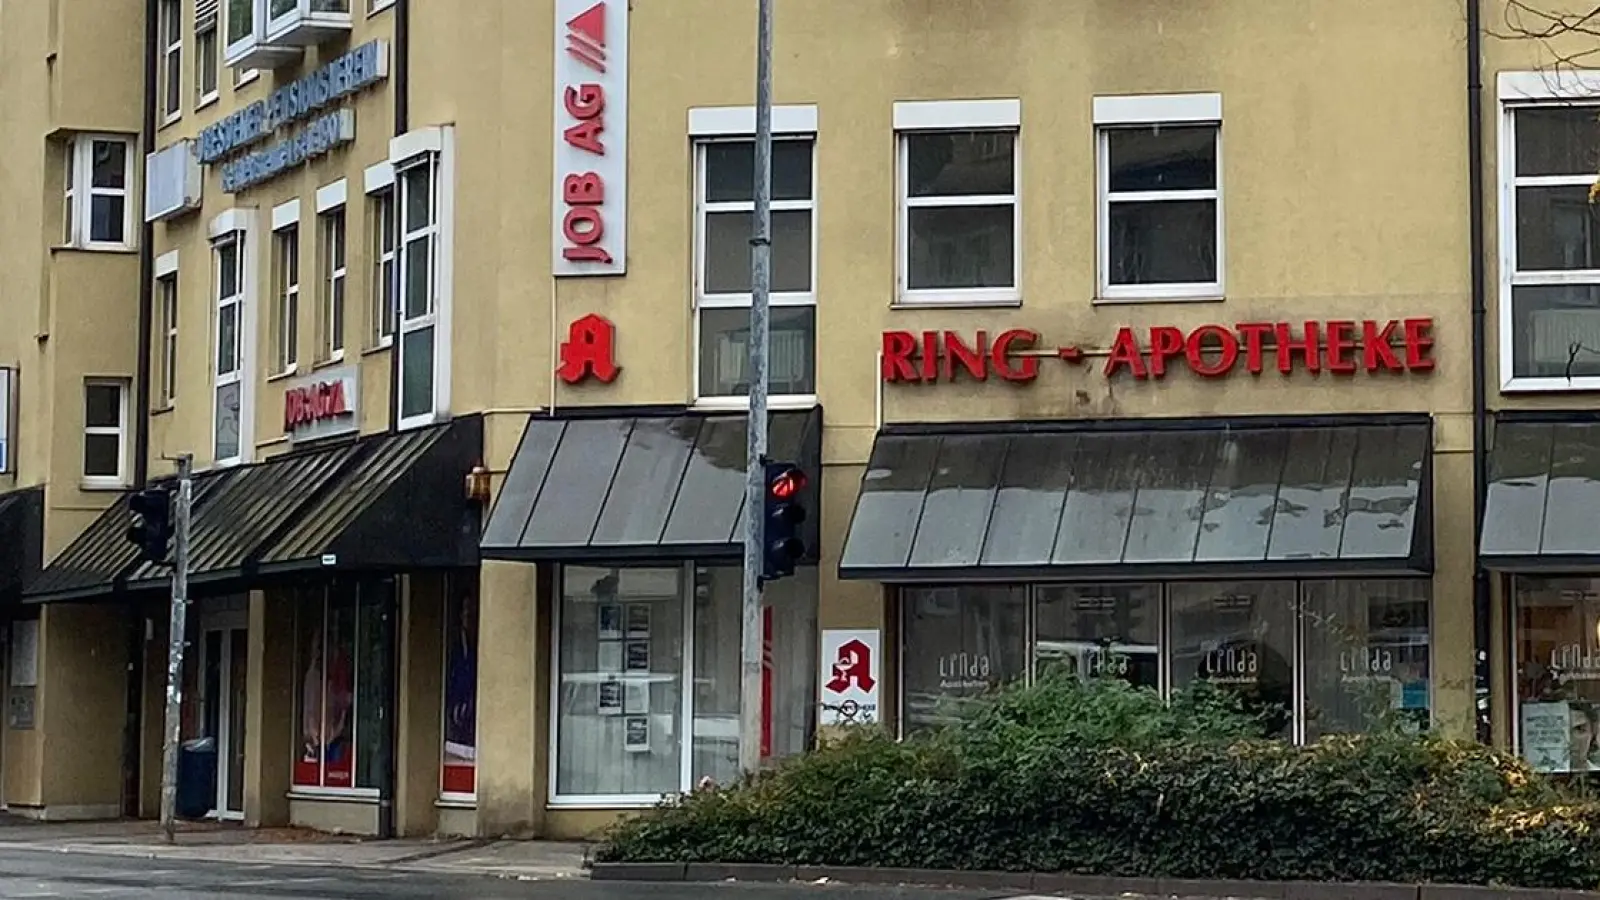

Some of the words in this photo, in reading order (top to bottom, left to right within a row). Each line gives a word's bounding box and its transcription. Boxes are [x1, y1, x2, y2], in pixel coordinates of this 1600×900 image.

[563, 84, 606, 156] AG
[563, 171, 613, 264] JOB
[882, 329, 1040, 381] RING
[1104, 318, 1435, 380] APOTHEKE
